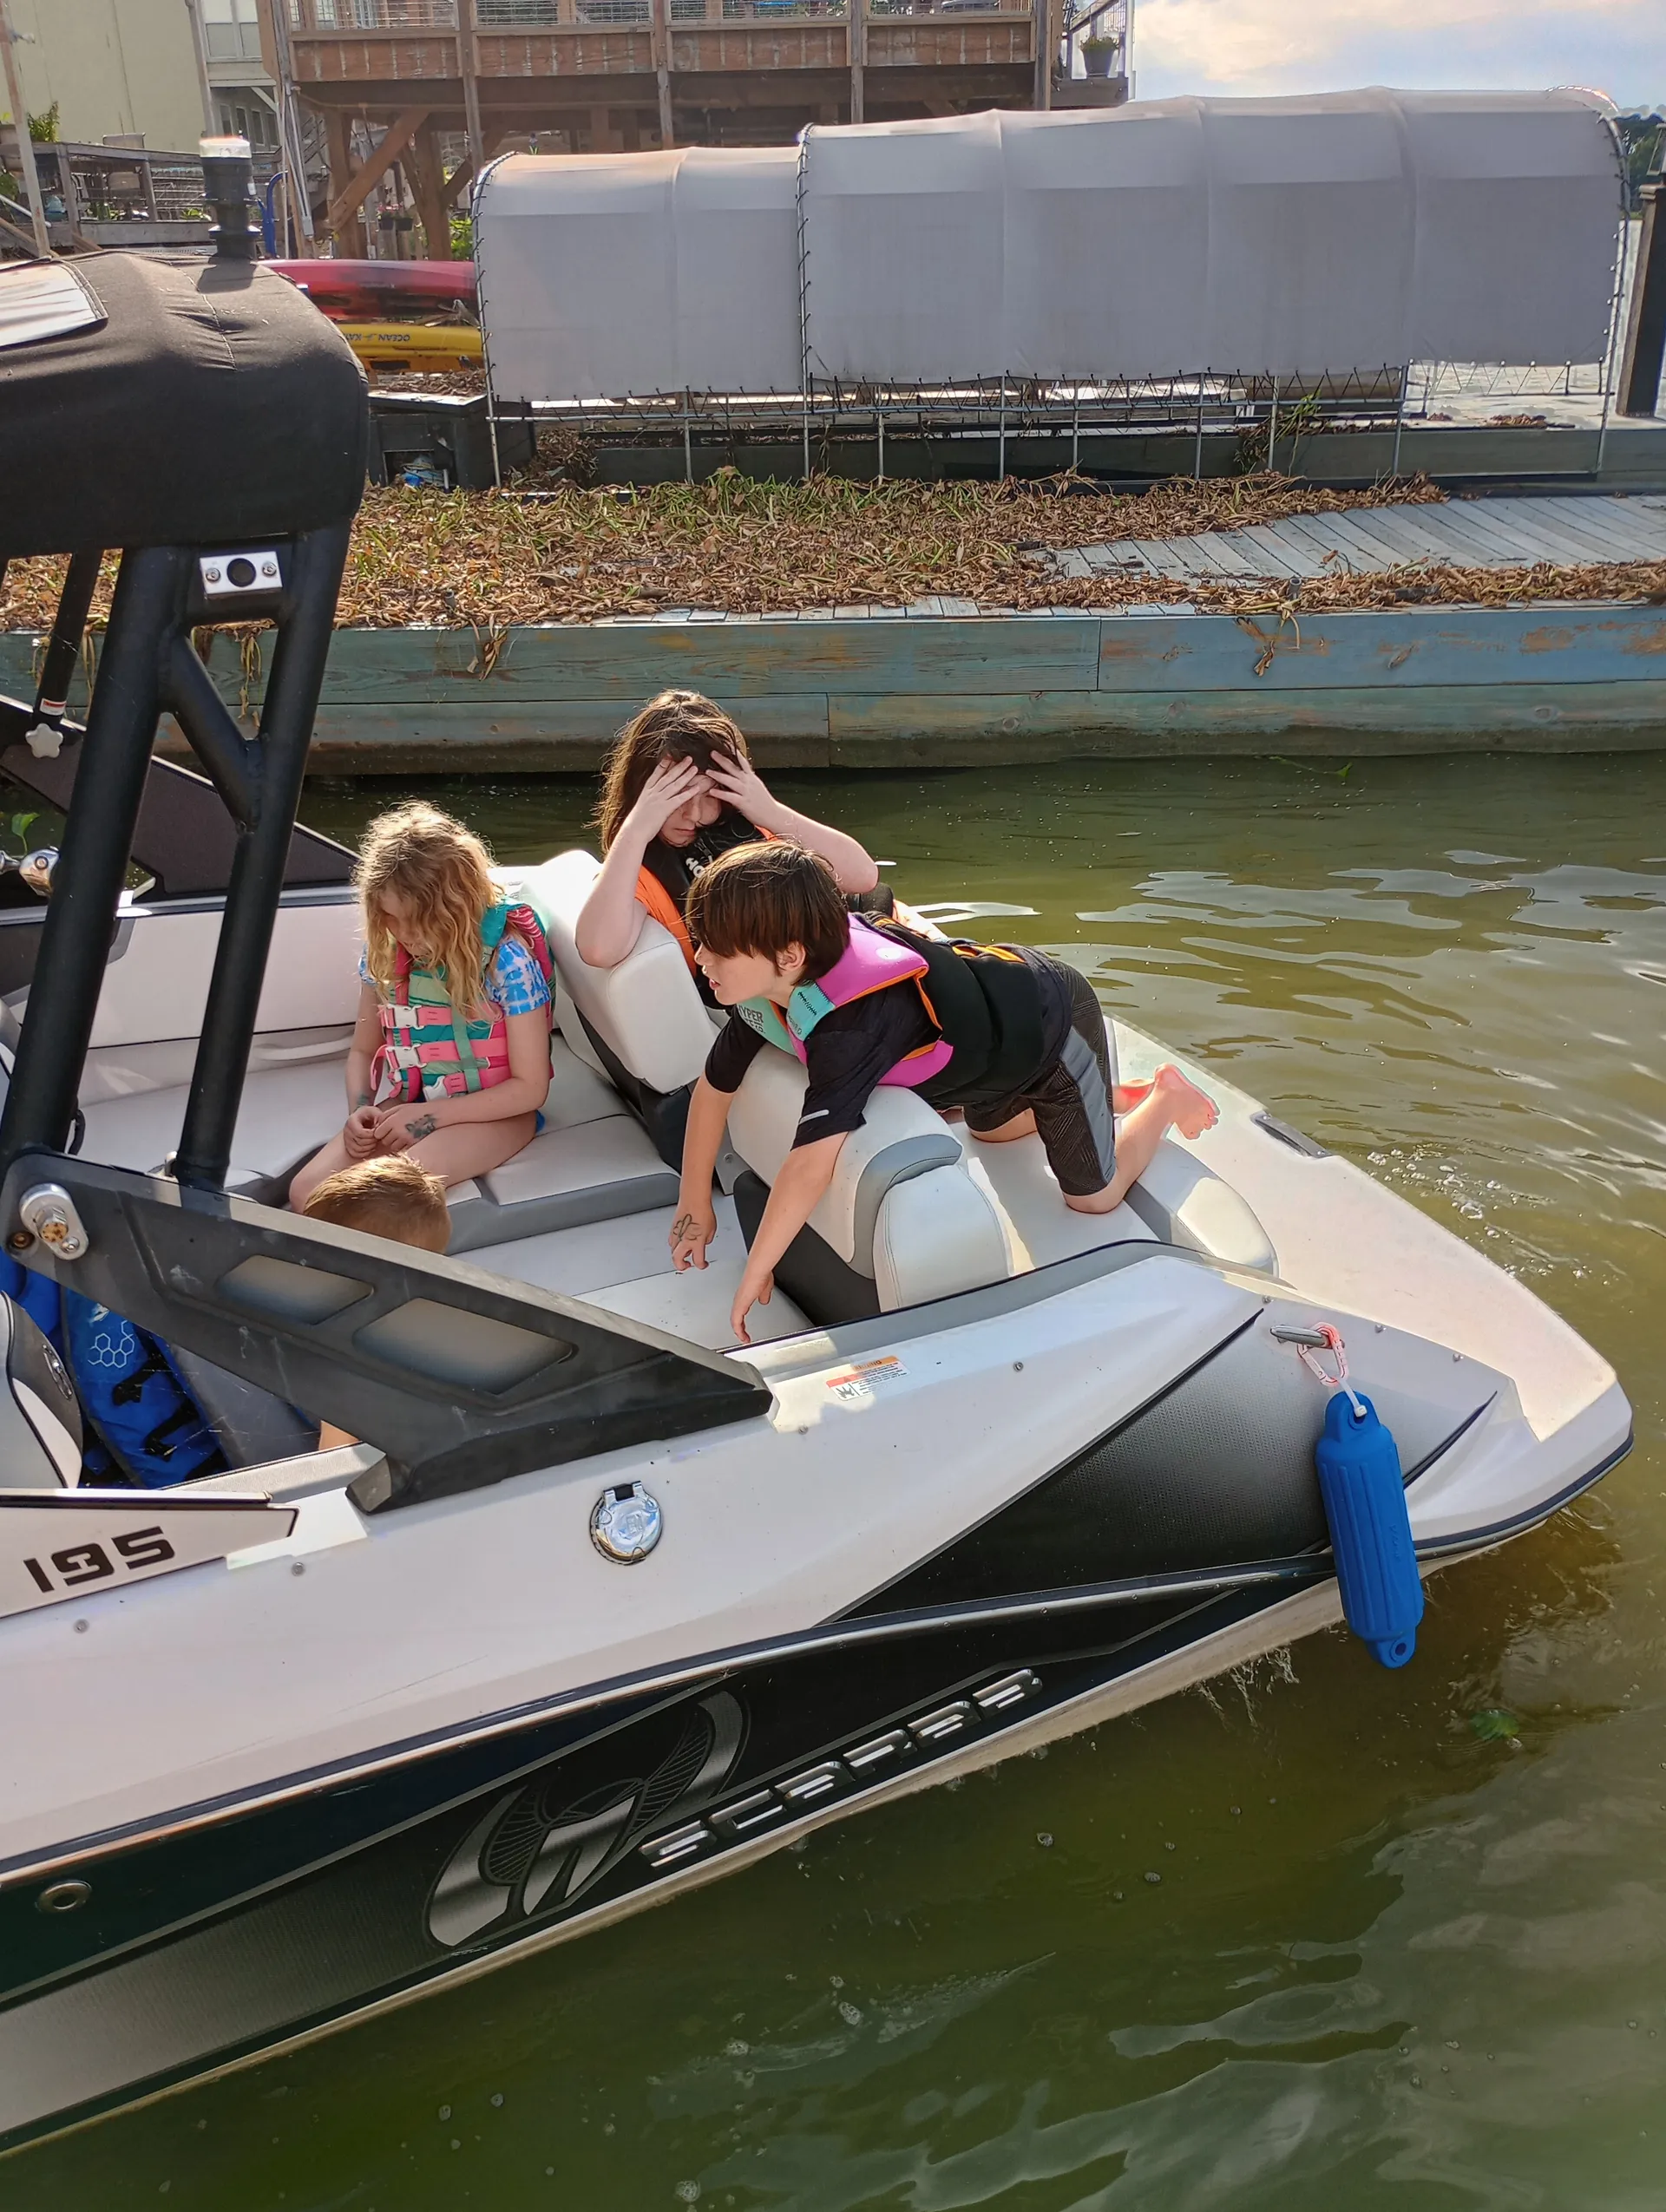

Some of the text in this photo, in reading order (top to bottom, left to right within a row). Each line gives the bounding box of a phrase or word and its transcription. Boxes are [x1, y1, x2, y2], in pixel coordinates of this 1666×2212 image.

[378, 333, 410, 343] OCEAN
[23, 1525, 175, 1594] 195
[638, 1668, 1044, 1871] SCARAB
